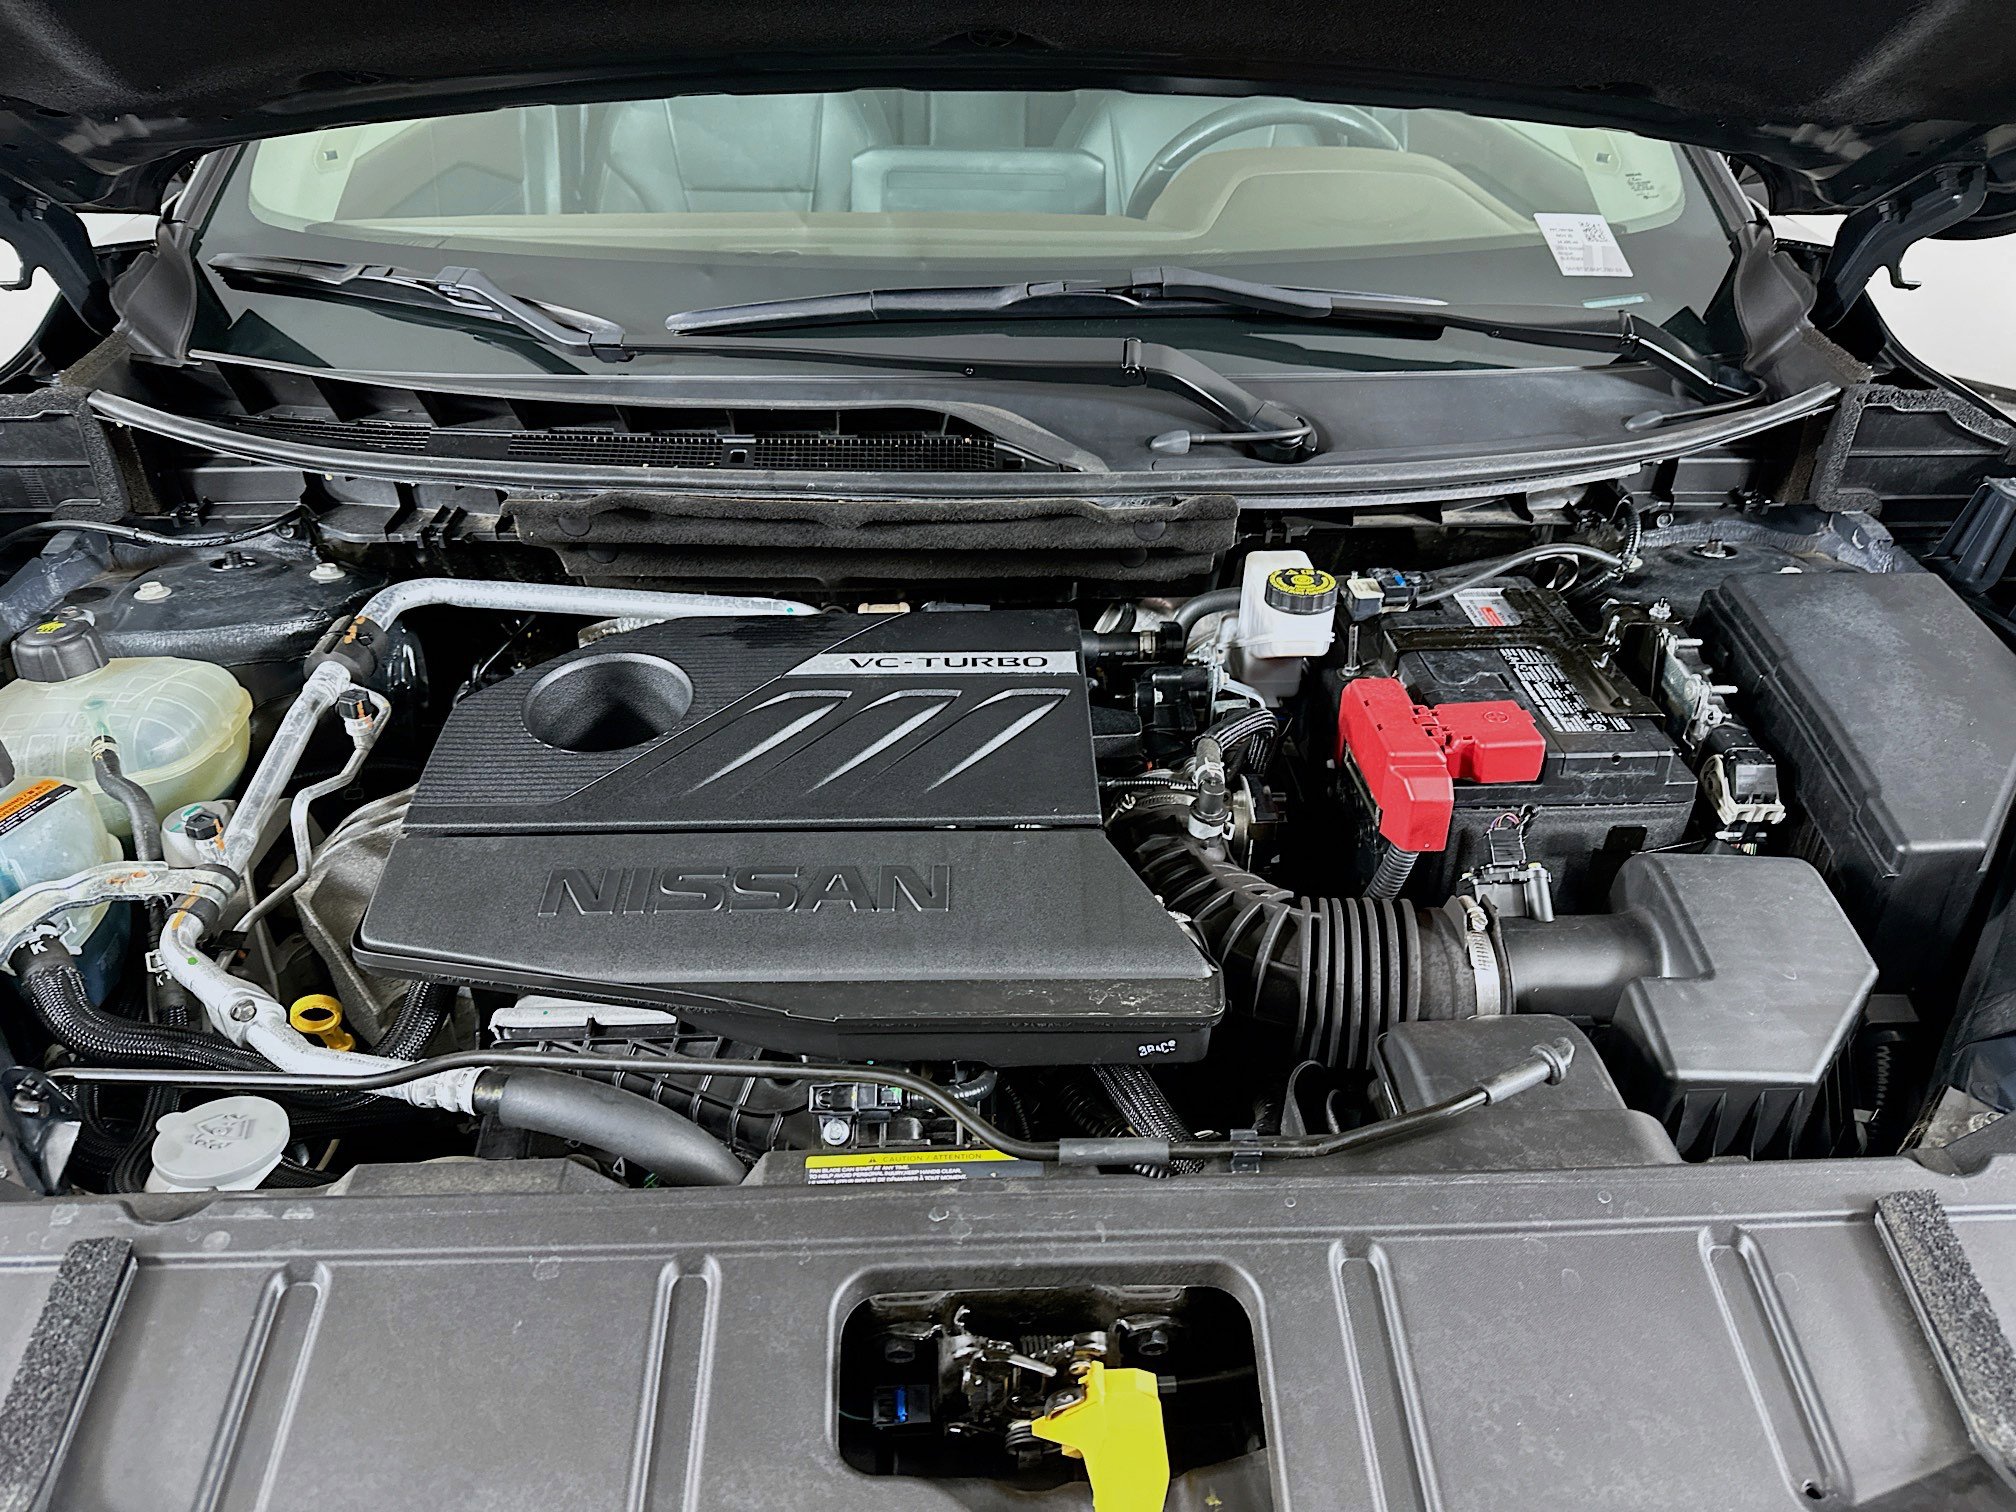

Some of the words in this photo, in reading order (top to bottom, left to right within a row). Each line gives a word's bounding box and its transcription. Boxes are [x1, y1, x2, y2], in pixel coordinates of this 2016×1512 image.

[848, 656, 1049, 669] VC-TURBO
[537, 864, 951, 916] NISSAN
[882, 1155, 923, 1163] CAUTION
[933, 1153, 982, 1161] ATTENTION
